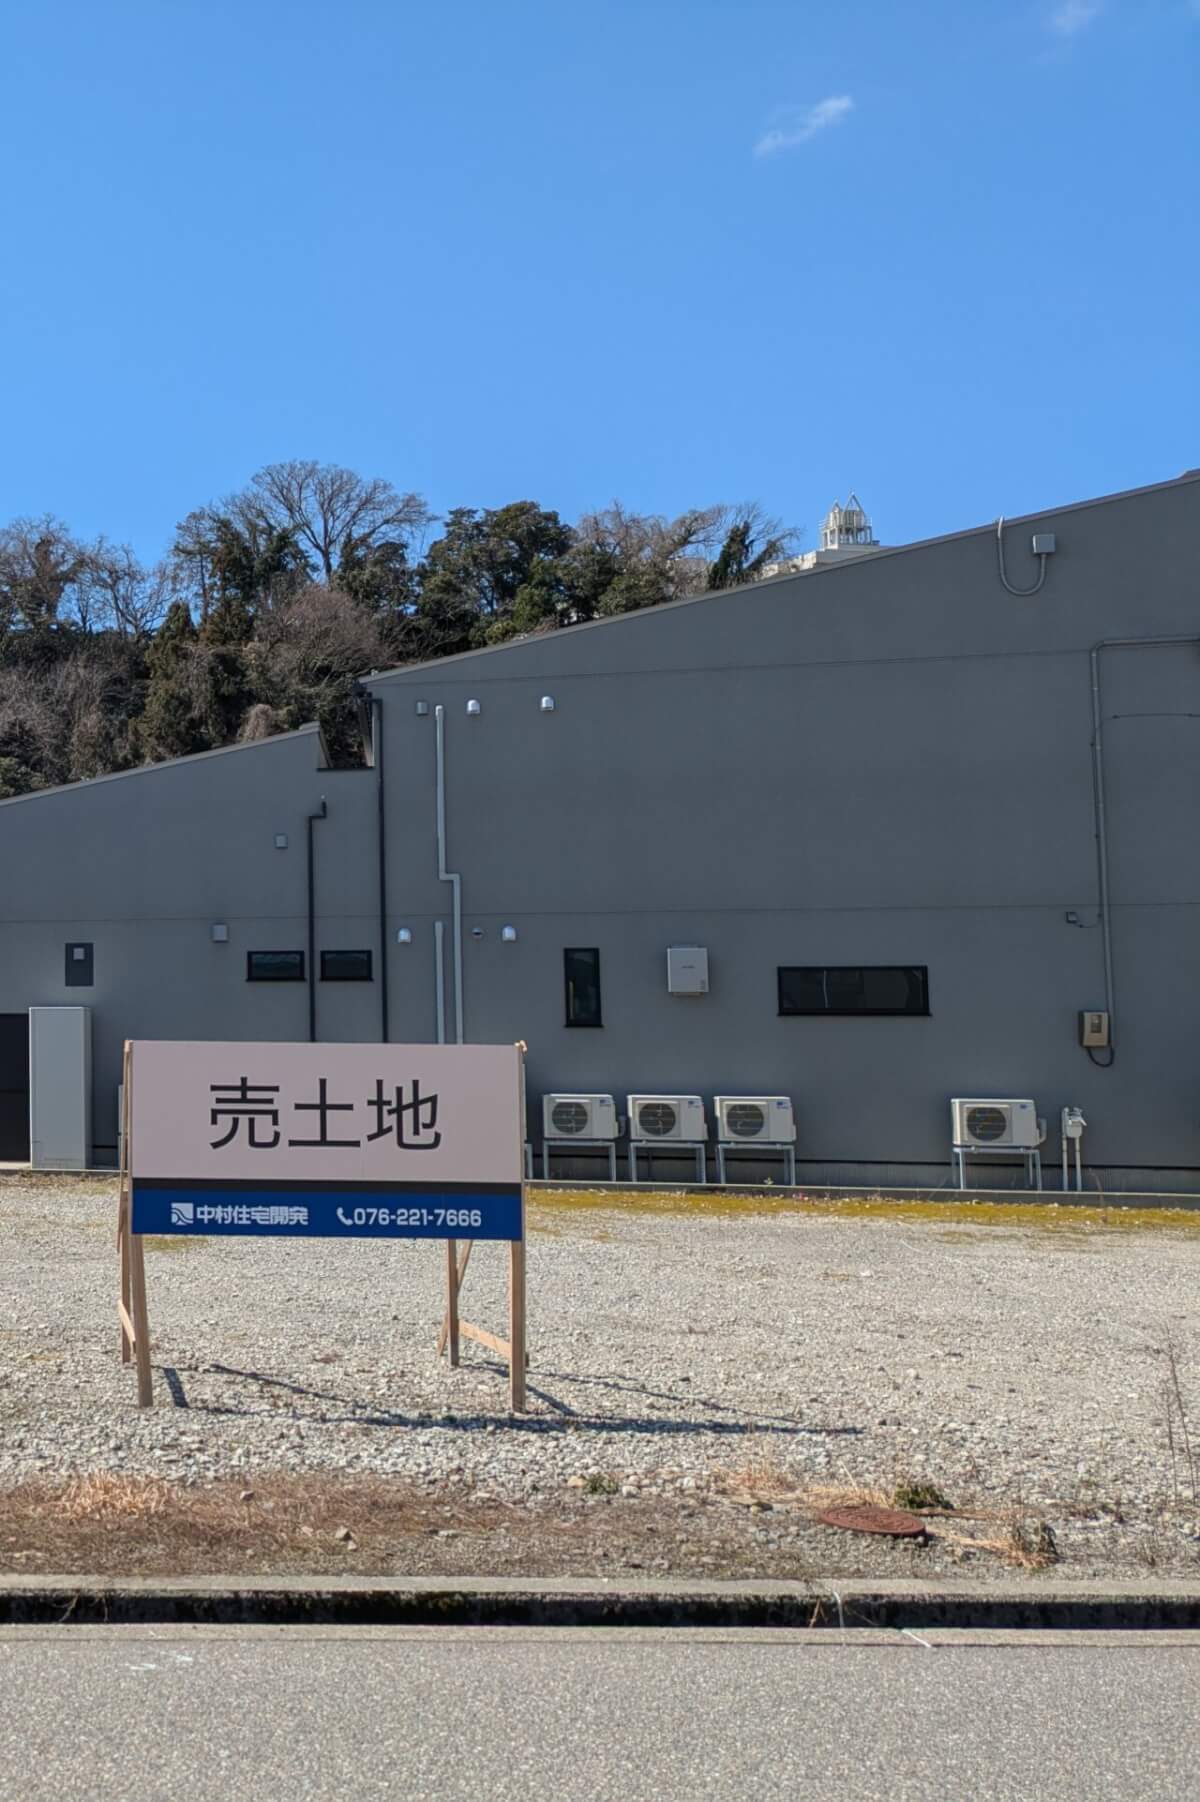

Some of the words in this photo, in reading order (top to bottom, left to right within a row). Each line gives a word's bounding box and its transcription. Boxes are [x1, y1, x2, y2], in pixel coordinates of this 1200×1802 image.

[209, 1076, 442, 1150] 売土地
[196, 1204, 309, 1226] 中村住宅開発
[353, 1207, 482, 1227] 076-221-7666
